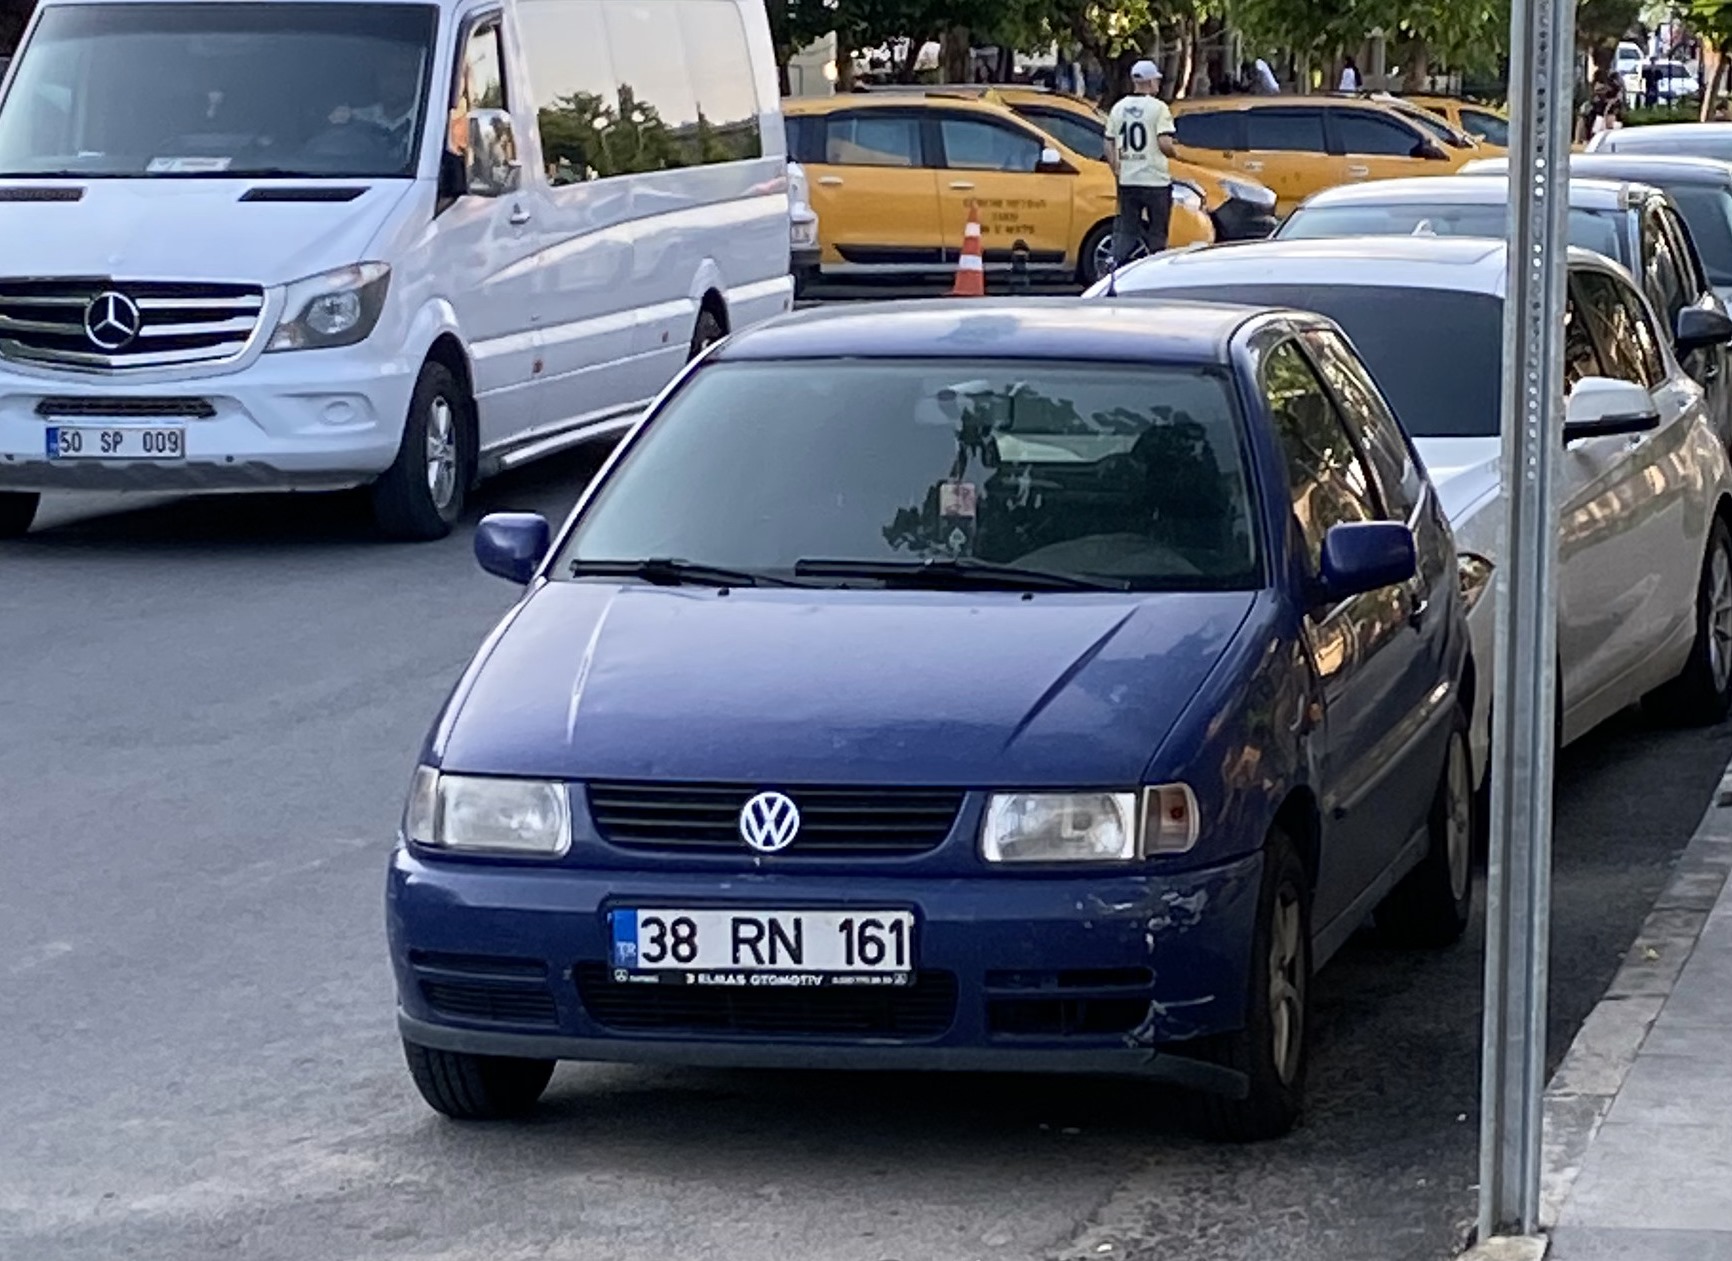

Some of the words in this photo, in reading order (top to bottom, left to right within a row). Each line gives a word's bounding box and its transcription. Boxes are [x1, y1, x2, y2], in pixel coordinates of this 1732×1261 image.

[1118, 121, 1147, 153] 10
[59, 431, 83, 453] 50
[100, 431, 124, 453] SP
[143, 431, 179, 453] 009
[641, 916, 698, 964] 38
[731, 916, 803, 965] RN
[838, 917, 905, 967] 161
